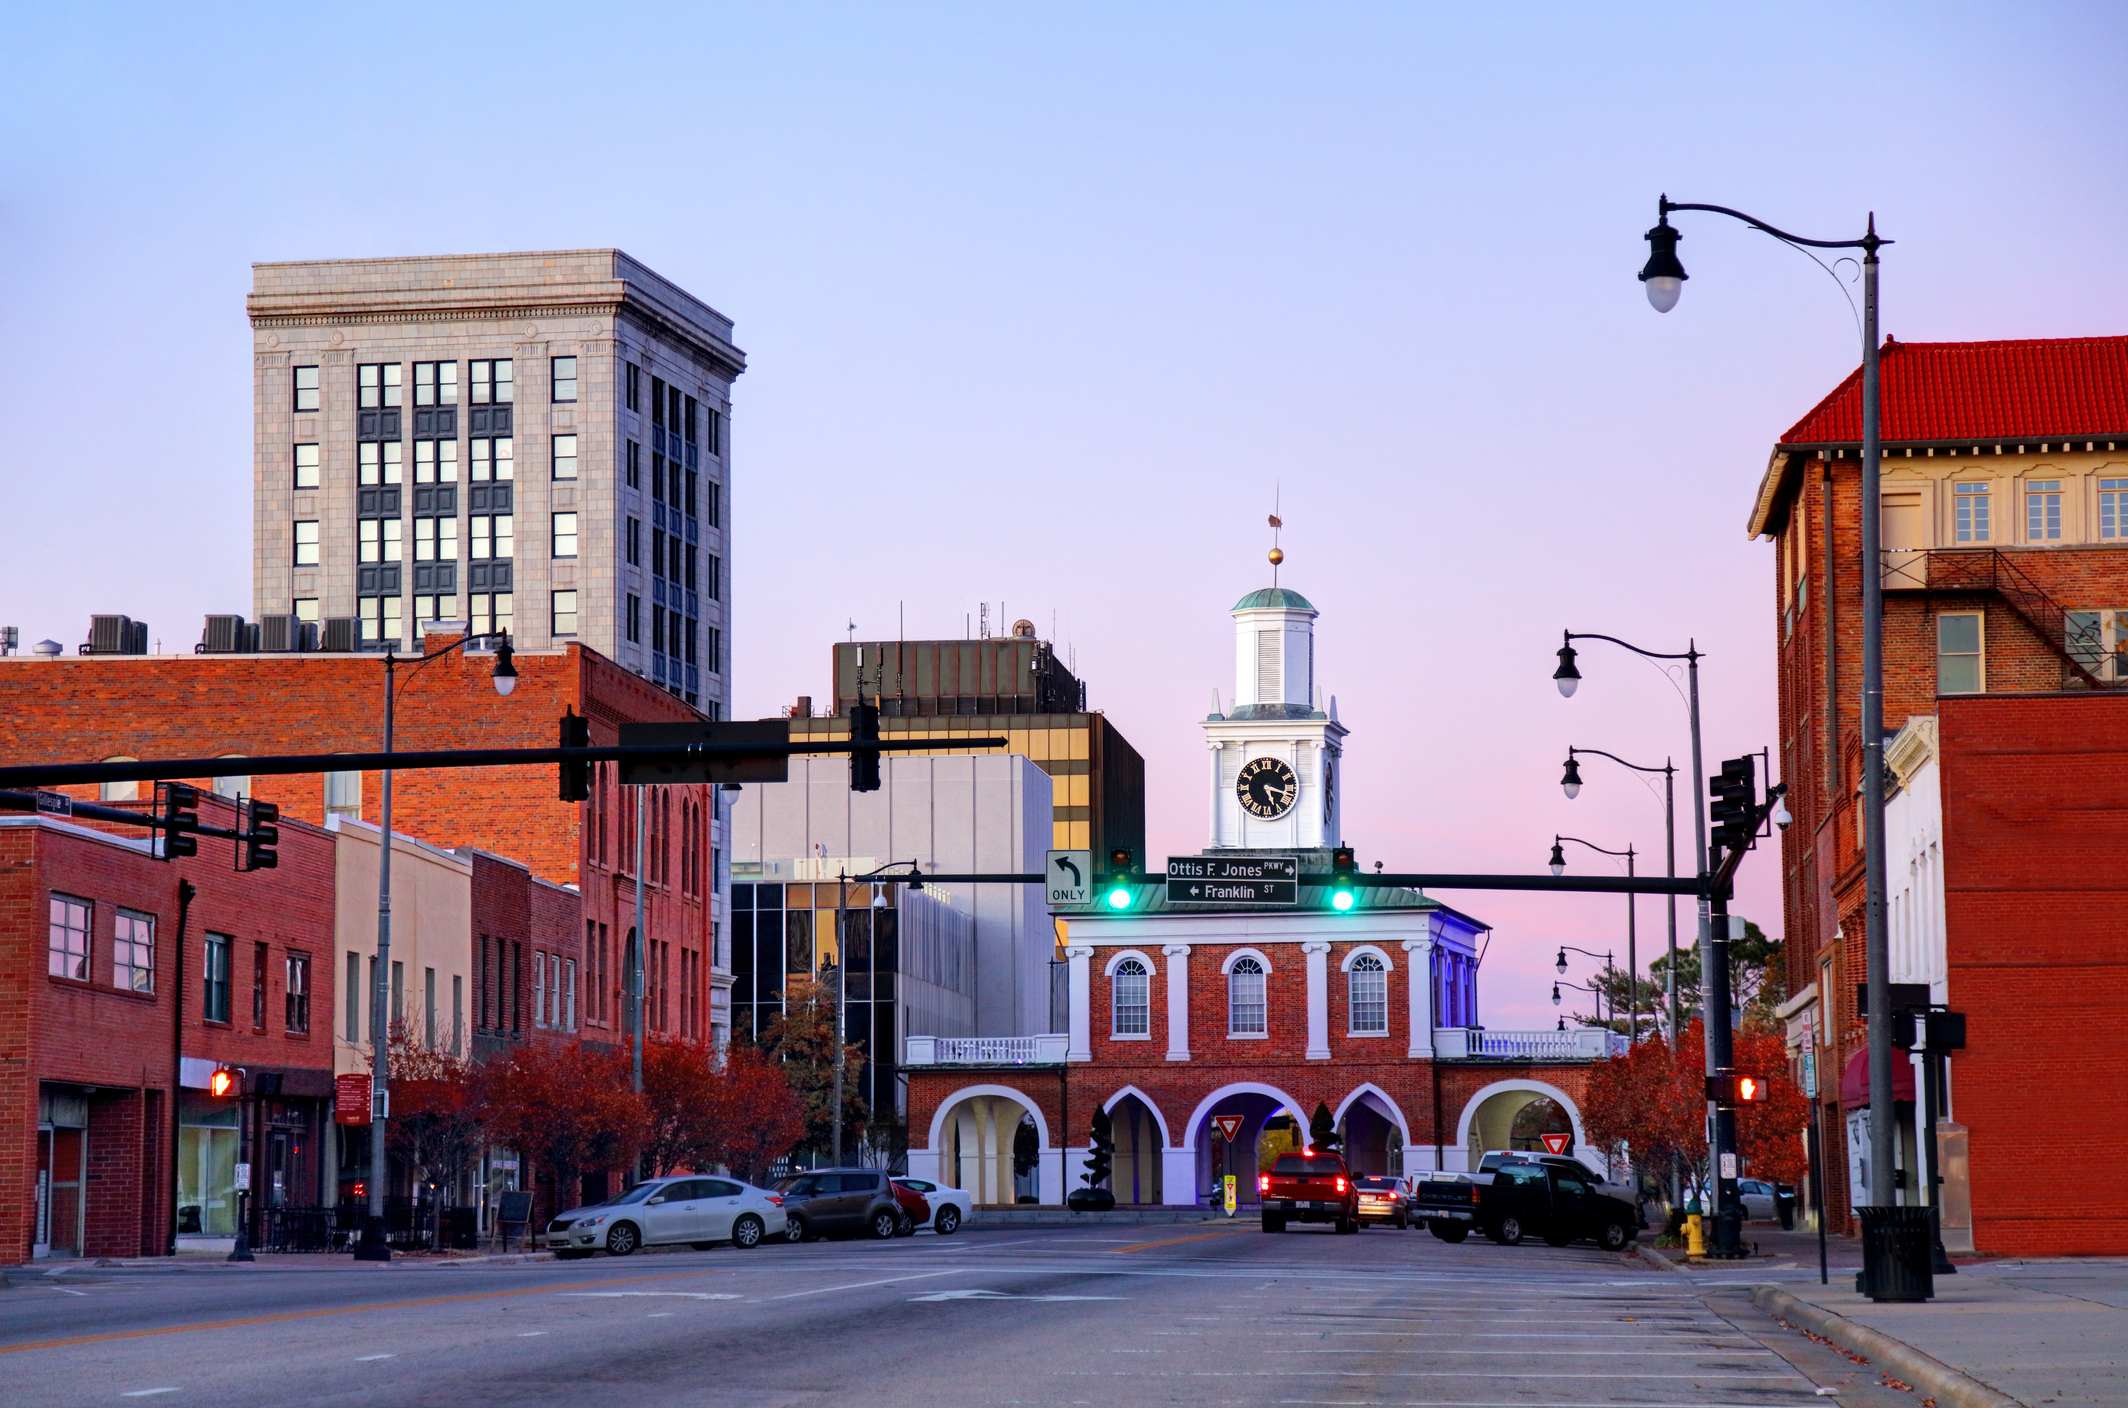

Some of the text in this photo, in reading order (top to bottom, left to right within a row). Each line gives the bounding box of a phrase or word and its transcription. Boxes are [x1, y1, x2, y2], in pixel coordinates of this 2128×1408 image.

[1169, 861, 1284, 877] Ottis F. Jones PKWY
[1052, 889, 1085, 900] ONLY
[1205, 884, 1275, 899] Franklin ST
[1422, 1193, 1468, 1201] CHEVROLET
